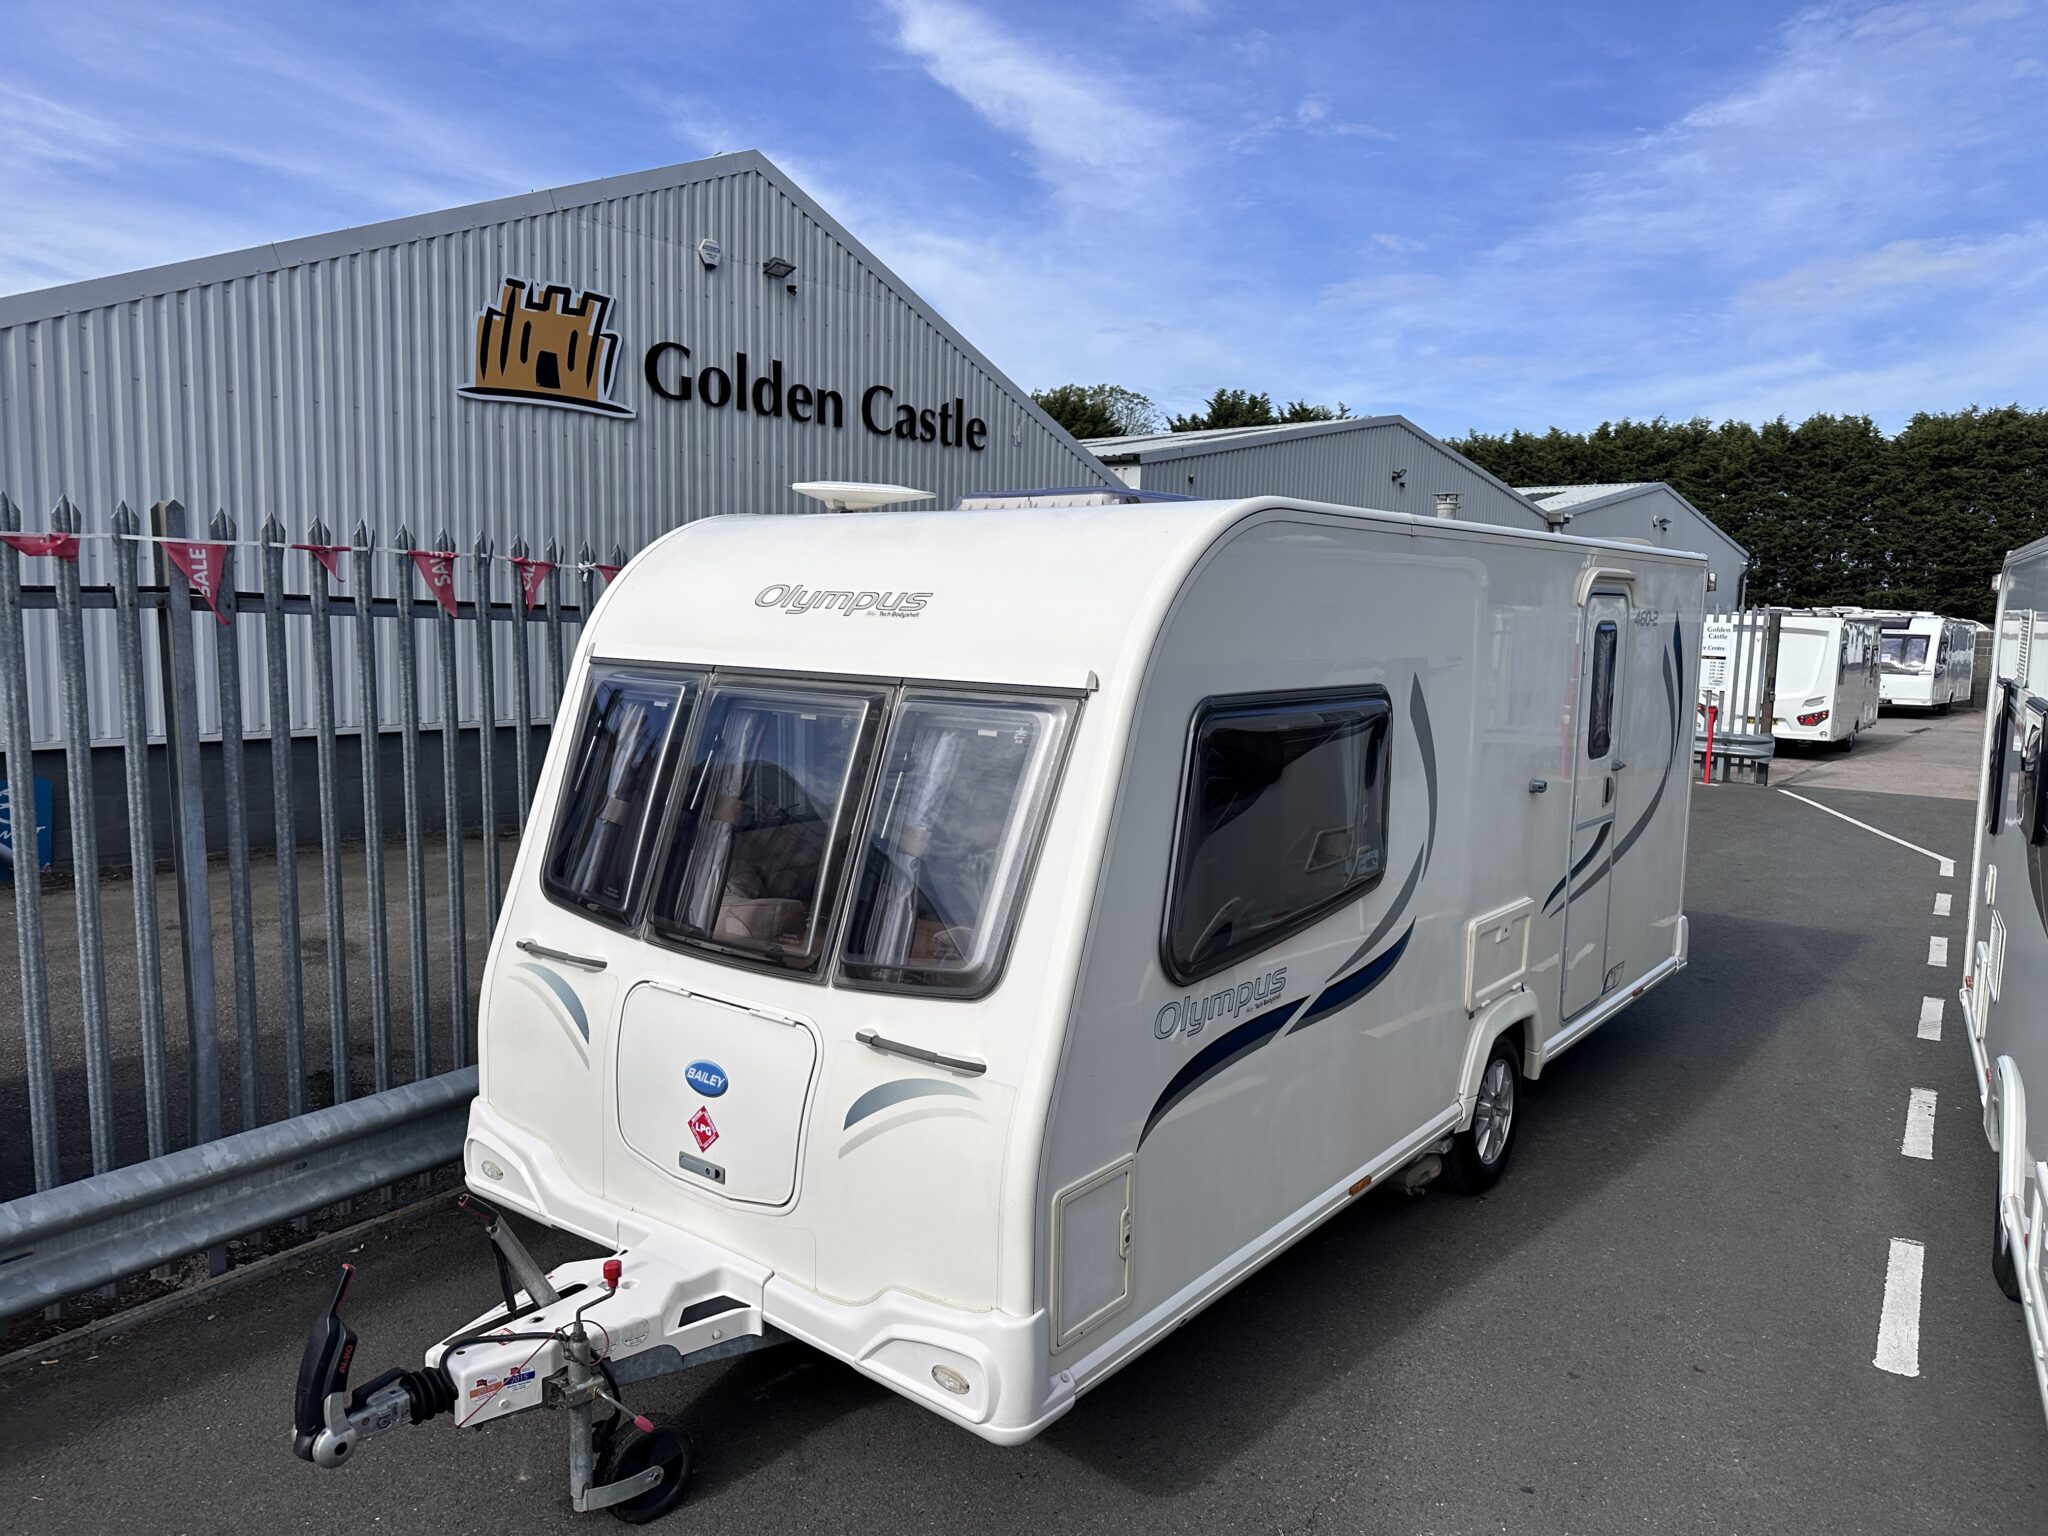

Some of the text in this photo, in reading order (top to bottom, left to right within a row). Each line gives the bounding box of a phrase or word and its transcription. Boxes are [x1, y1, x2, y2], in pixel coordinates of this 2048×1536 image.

[644, 341, 987, 451] Golden Castle
[189, 548, 211, 598] SALE
[754, 584, 934, 617] Olympus
[1153, 966, 1288, 1040] Olympus
[686, 1067, 725, 1089] BAILEY
[695, 1121, 712, 1137] LPG
